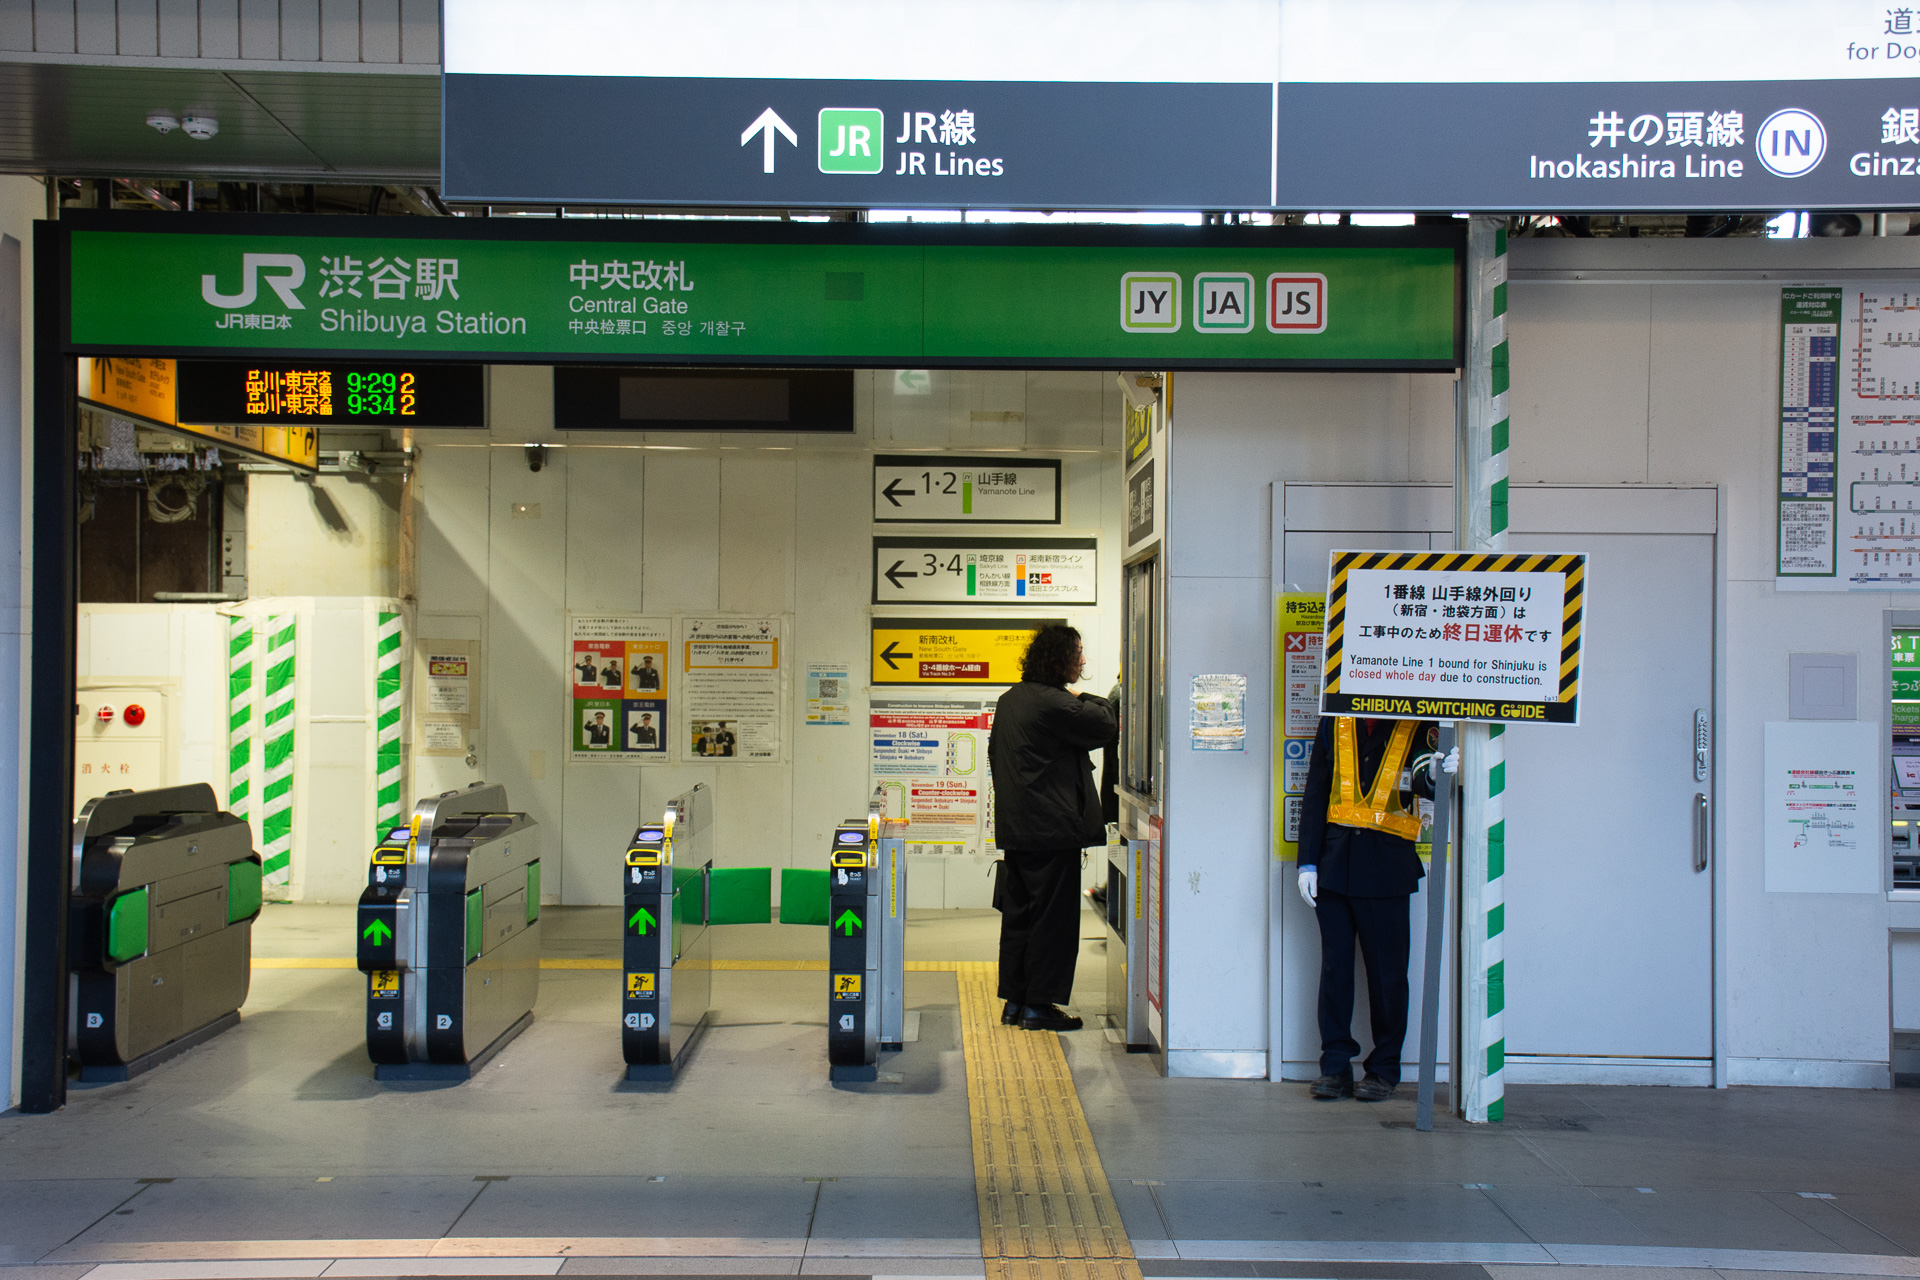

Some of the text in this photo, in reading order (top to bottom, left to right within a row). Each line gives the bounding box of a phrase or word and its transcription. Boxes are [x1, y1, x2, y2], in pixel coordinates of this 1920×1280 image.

[1884, 7, 1920, 36] 道
[1846, 42, 1920, 62] for Do
[896, 109, 977, 146] JR線
[1587, 110, 1745, 148] 井の頭線
[829, 125, 871, 157] JR
[1771, 129, 1811, 157] IN
[896, 152, 1004, 176] JR Lines
[1530, 153, 1743, 178] Inokashira Line
[201, 253, 306, 310] JR
[318, 255, 460, 301] 渋谷駅
[569, 259, 694, 292] 中央改札
[569, 295, 688, 315] Central Gate
[1134, 290, 1168, 314] JY
[1206, 290, 1242, 315] JA
[1281, 291, 1311, 315] JS
[215, 313, 292, 330] JR東日本
[320, 308, 527, 339] Shibuya Station
[568, 318, 647, 335] 中央检票口
[661, 319, 747, 337] 중앙 개찰구
[346, 372, 397, 394] 9:29
[400, 372, 415, 394] 2
[346, 394, 397, 415] 9:34
[400, 394, 415, 415] 2
[978, 472, 1017, 485] 山手線
[979, 554, 1004, 563] 埼京線
[1029, 554, 1082, 563] 湘南新宿ライン
[1384, 584, 1532, 602] 1番線 山手線外回り
[1392, 604, 1526, 619] （新宿・池袋方面）は
[918, 635, 958, 645] 新南改札
[1358, 622, 1552, 643] 工事中のため終日運休です
[1350, 654, 1547, 672] Yamanote Line 1 bound for Shinjuku is
[1349, 668, 1543, 686] closed whole day due to construction.
[1351, 697, 1545, 719] SHIBUYA SWITCHING GUIDE
[908, 730, 928, 739] (Sat.)
[81, 762, 130, 774] 消火栓
[936, 780, 945, 788] 19
[946, 780, 968, 789] (Sun.)
[91, 1015, 98, 1026] 3
[382, 1014, 390, 1024] 3
[440, 1017, 447, 1026] 2
[630, 1015, 636, 1025] 2
[643, 1016, 649, 1025] 1
[845, 1017, 850, 1026] 1
